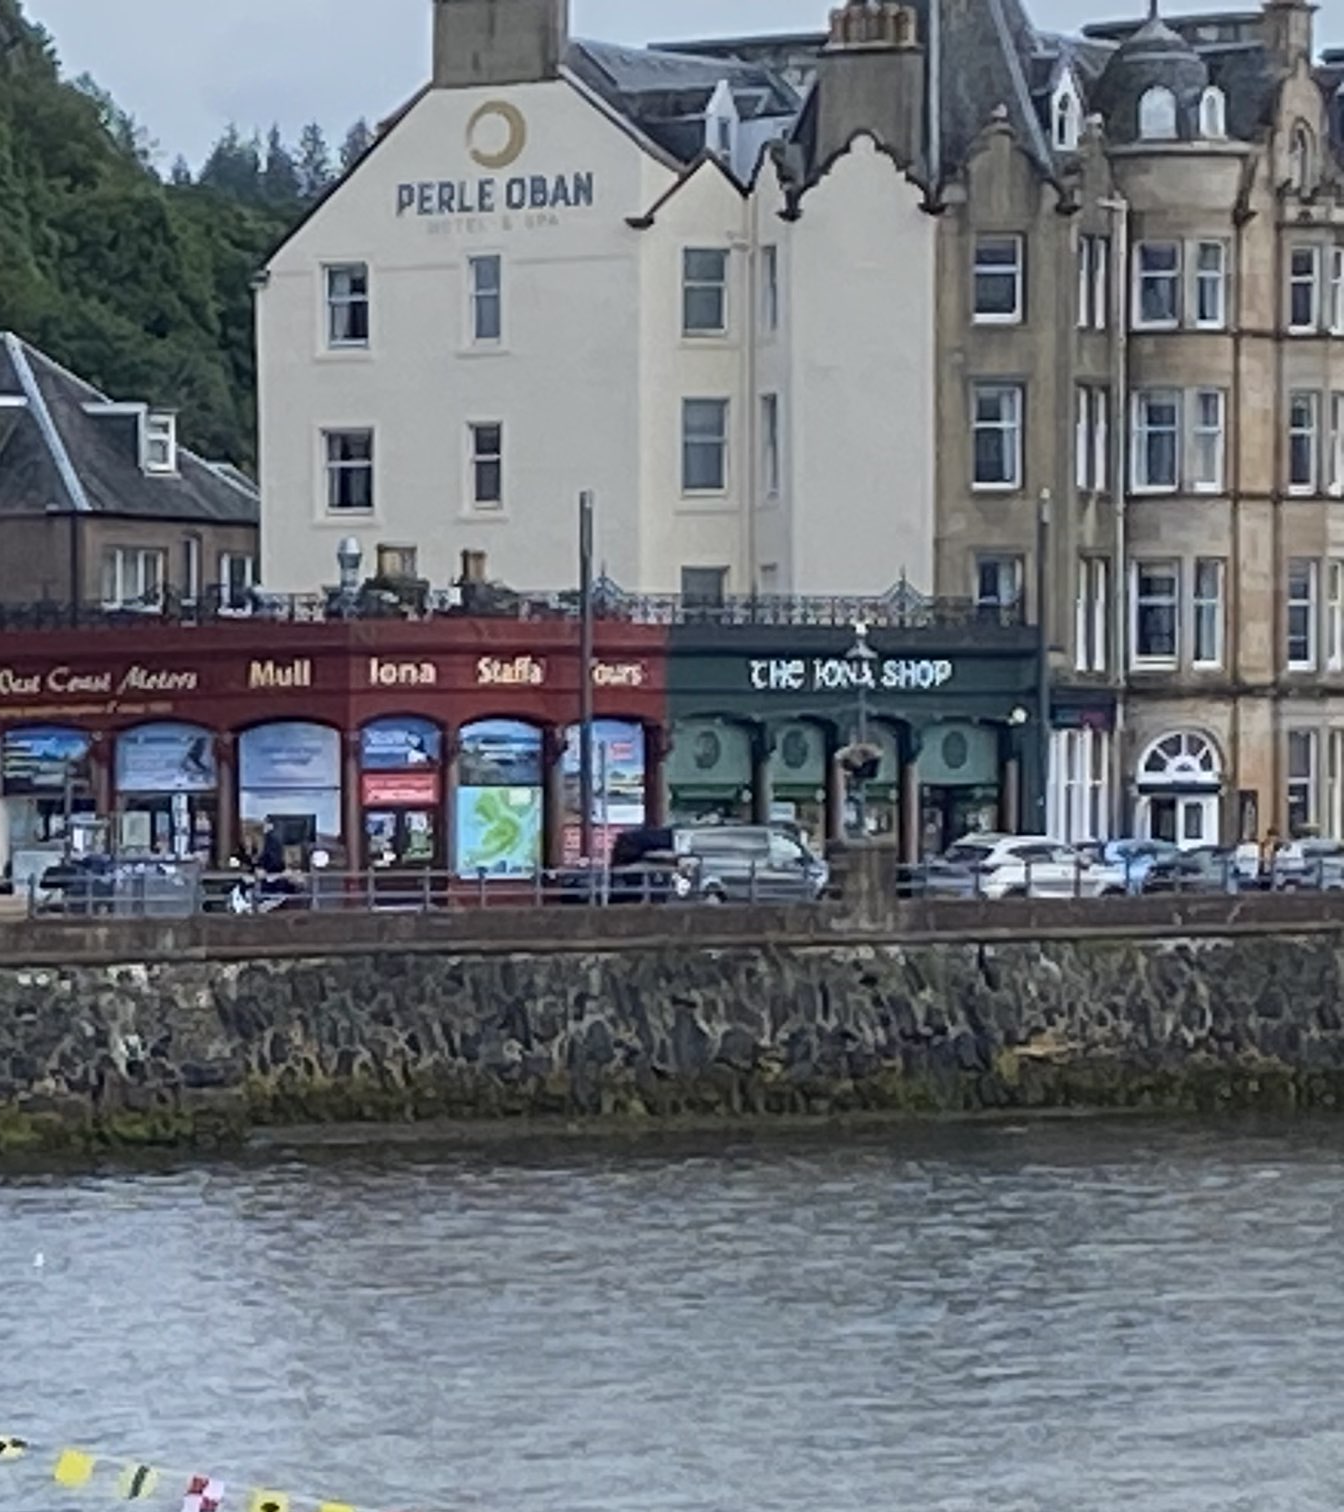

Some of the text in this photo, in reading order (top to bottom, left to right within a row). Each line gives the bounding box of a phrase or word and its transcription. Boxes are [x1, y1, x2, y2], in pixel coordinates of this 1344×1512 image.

[396, 171, 594, 217] PERLE OBAN
[427, 216, 486, 235] HOTEL
[524, 212, 559, 230] SPA
[47, 666, 112, 692] Coast
[115, 665, 198, 695] Motors
[249, 660, 311, 689] Mull
[369, 658, 437, 685] Iona
[477, 656, 543, 685] Staffa
[750, 659, 953, 691] THE IONA SHOP
